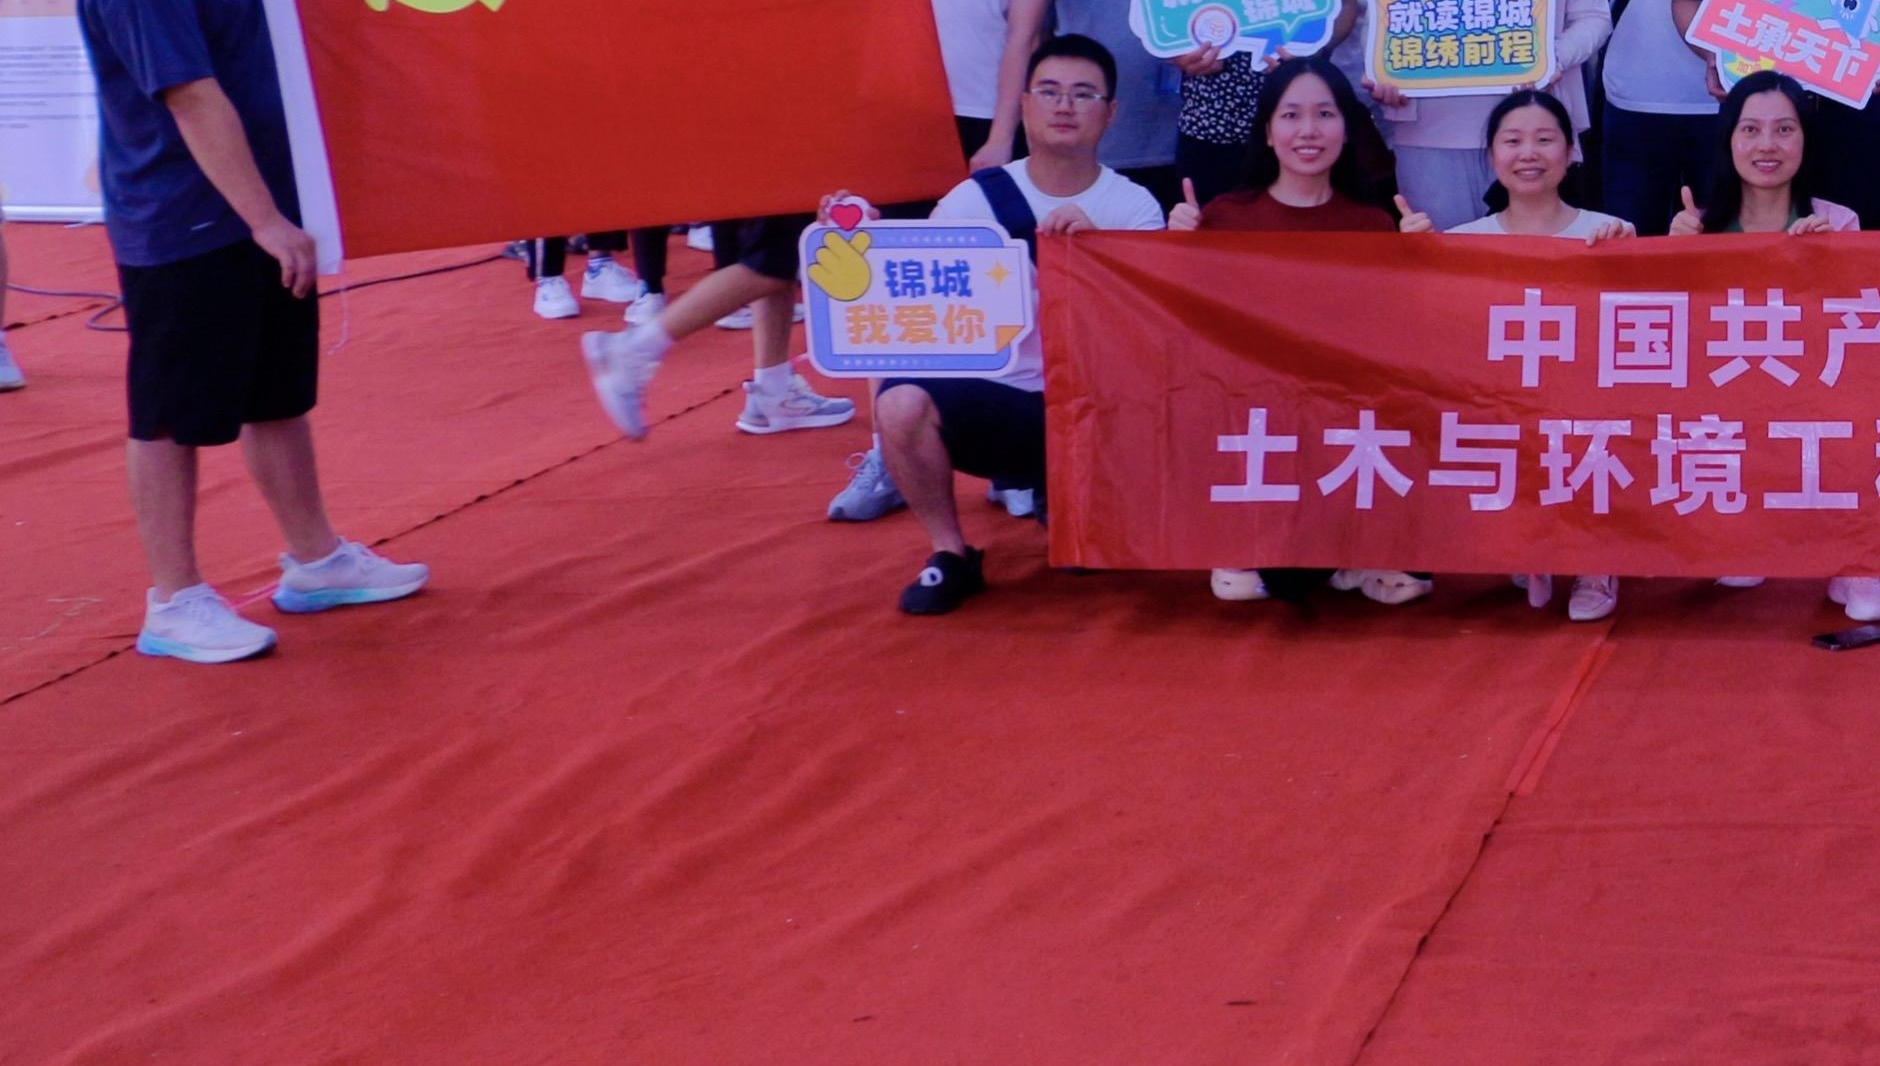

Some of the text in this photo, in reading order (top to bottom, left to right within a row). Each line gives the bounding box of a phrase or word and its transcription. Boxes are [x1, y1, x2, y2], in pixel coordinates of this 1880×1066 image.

[1389, 30, 1535, 70] 锦绣前程
[1710, 2, 1869, 83] 土承天下
[884, 259, 973, 298] 锦城
[845, 303, 986, 345] 我爱你
